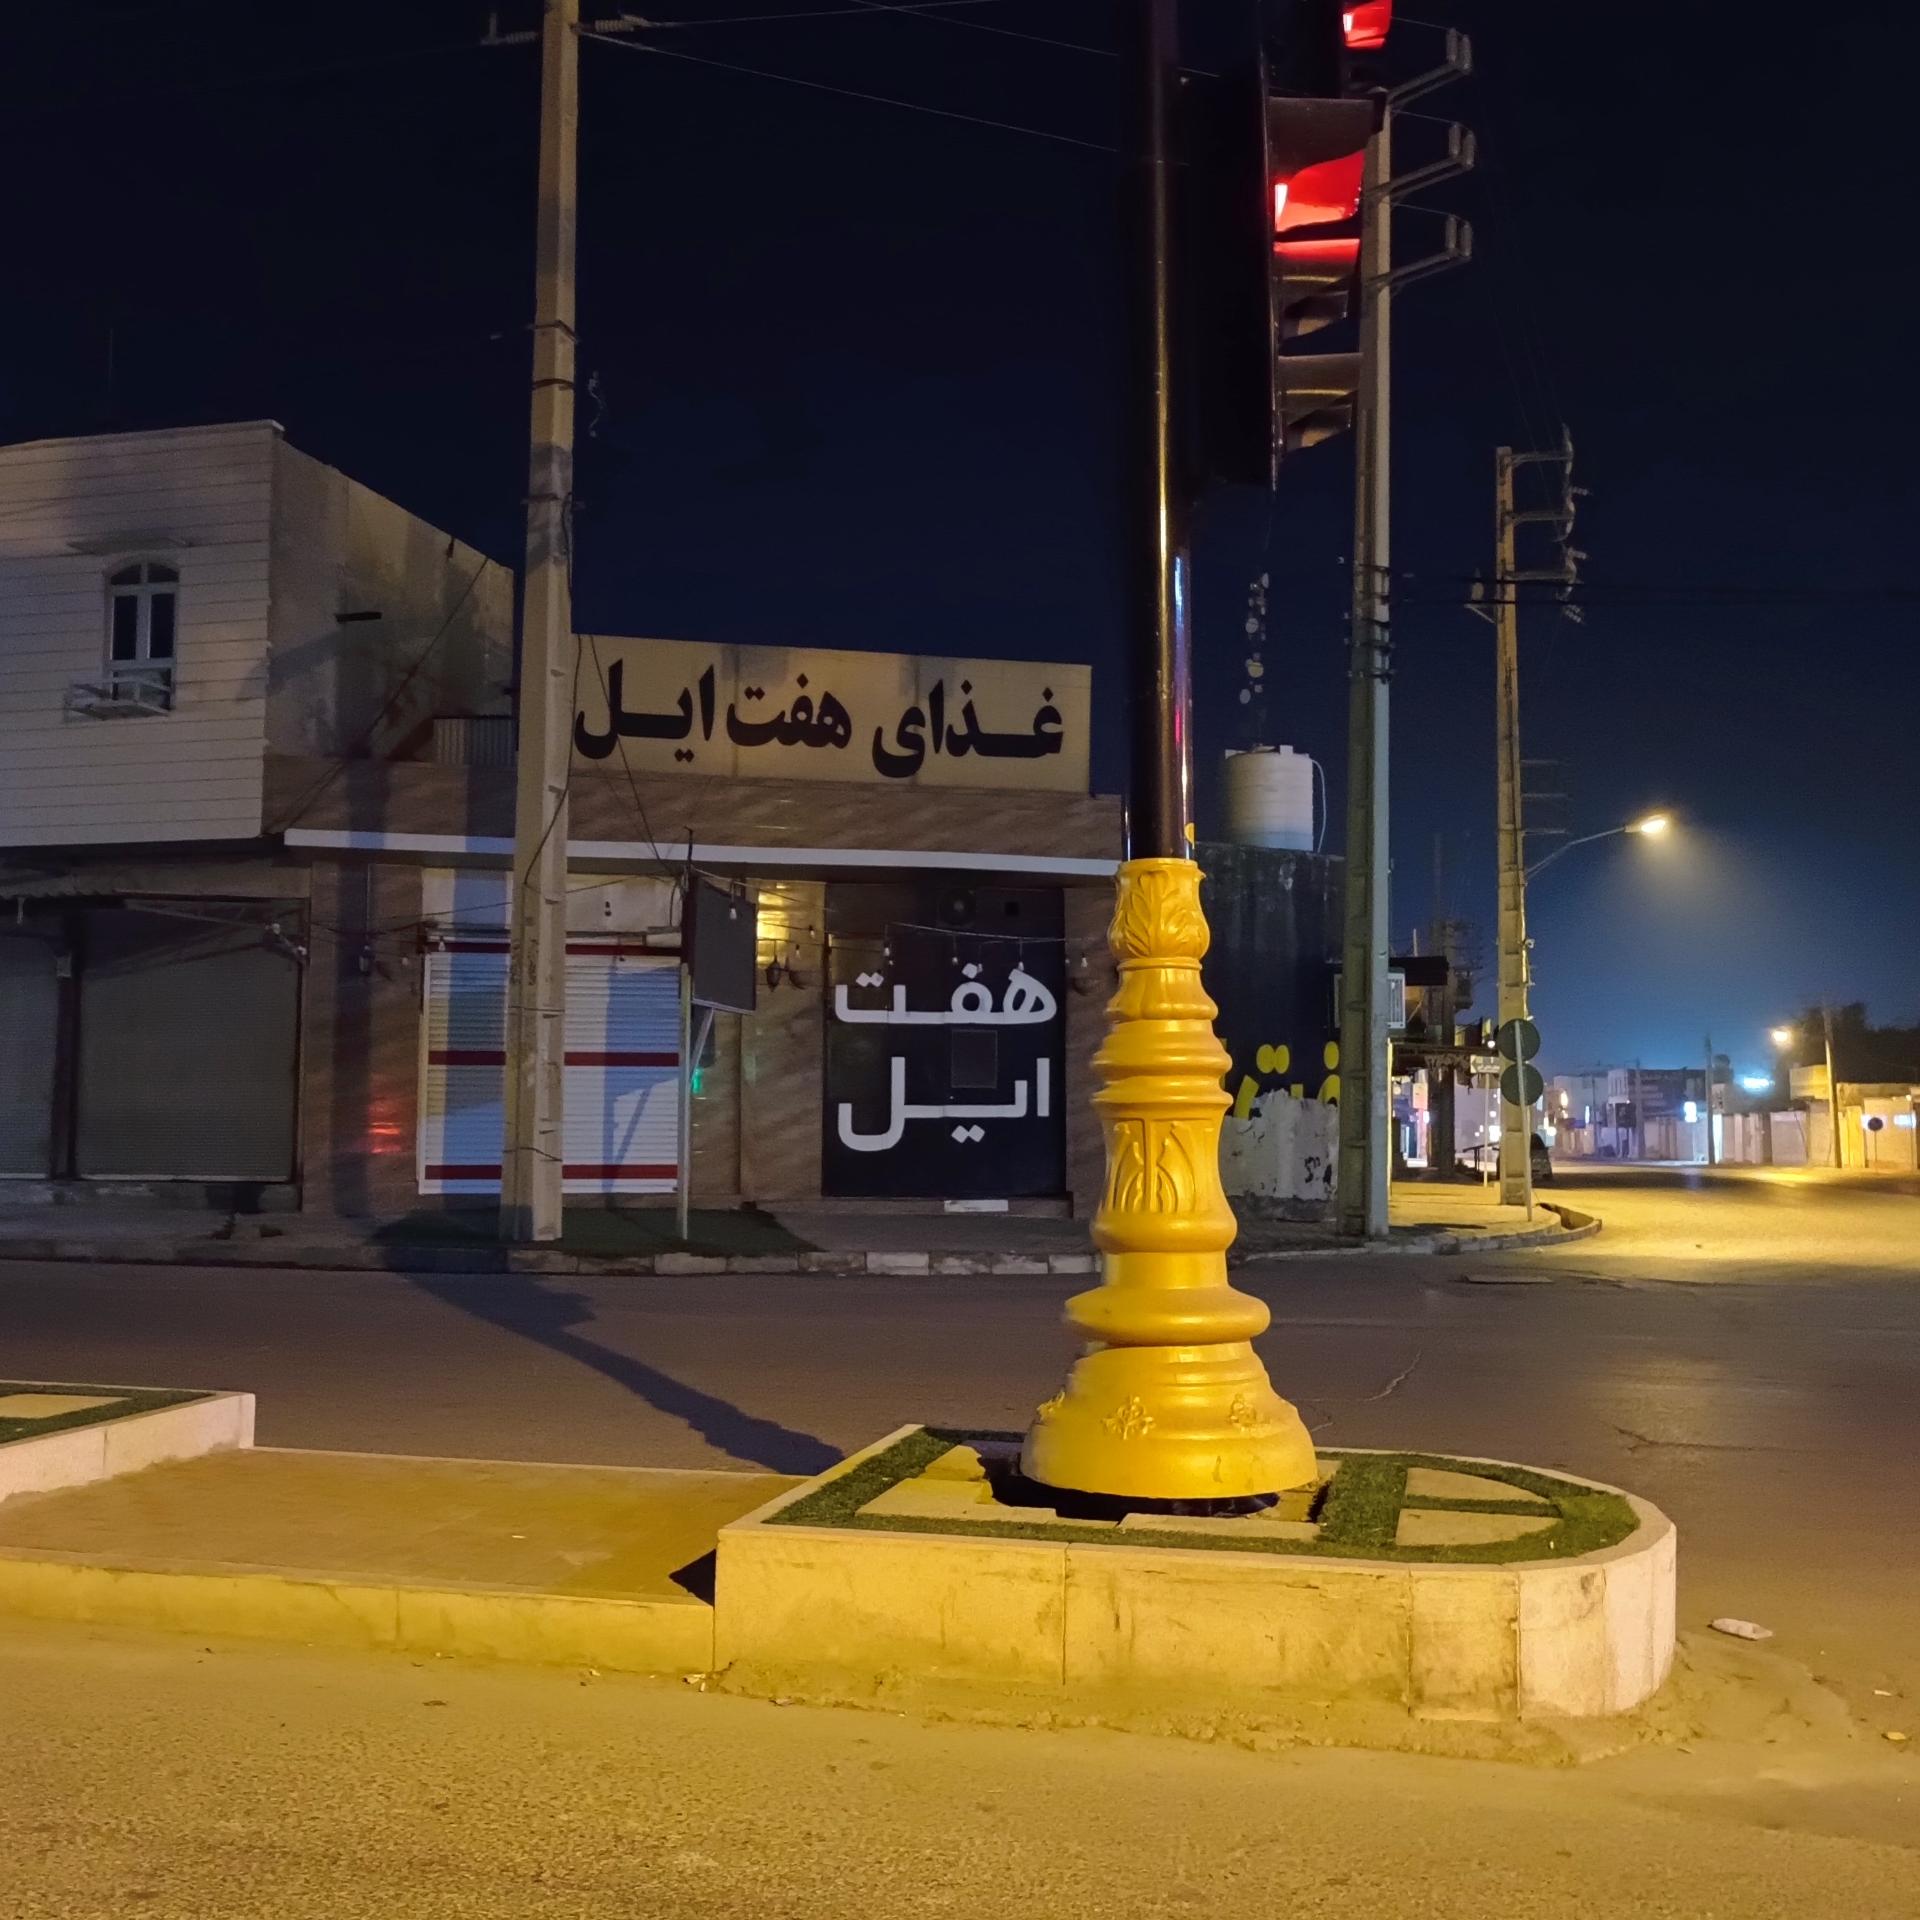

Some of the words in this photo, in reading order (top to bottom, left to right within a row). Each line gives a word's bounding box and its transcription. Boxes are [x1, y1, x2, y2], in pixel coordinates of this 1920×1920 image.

[573, 658, 716, 763] ایل
[726, 672, 853, 750] هفت
[871, 678, 1065, 779] غذای
[834, 962, 1057, 1025] هفت
[837, 1056, 1050, 1152] ایل
